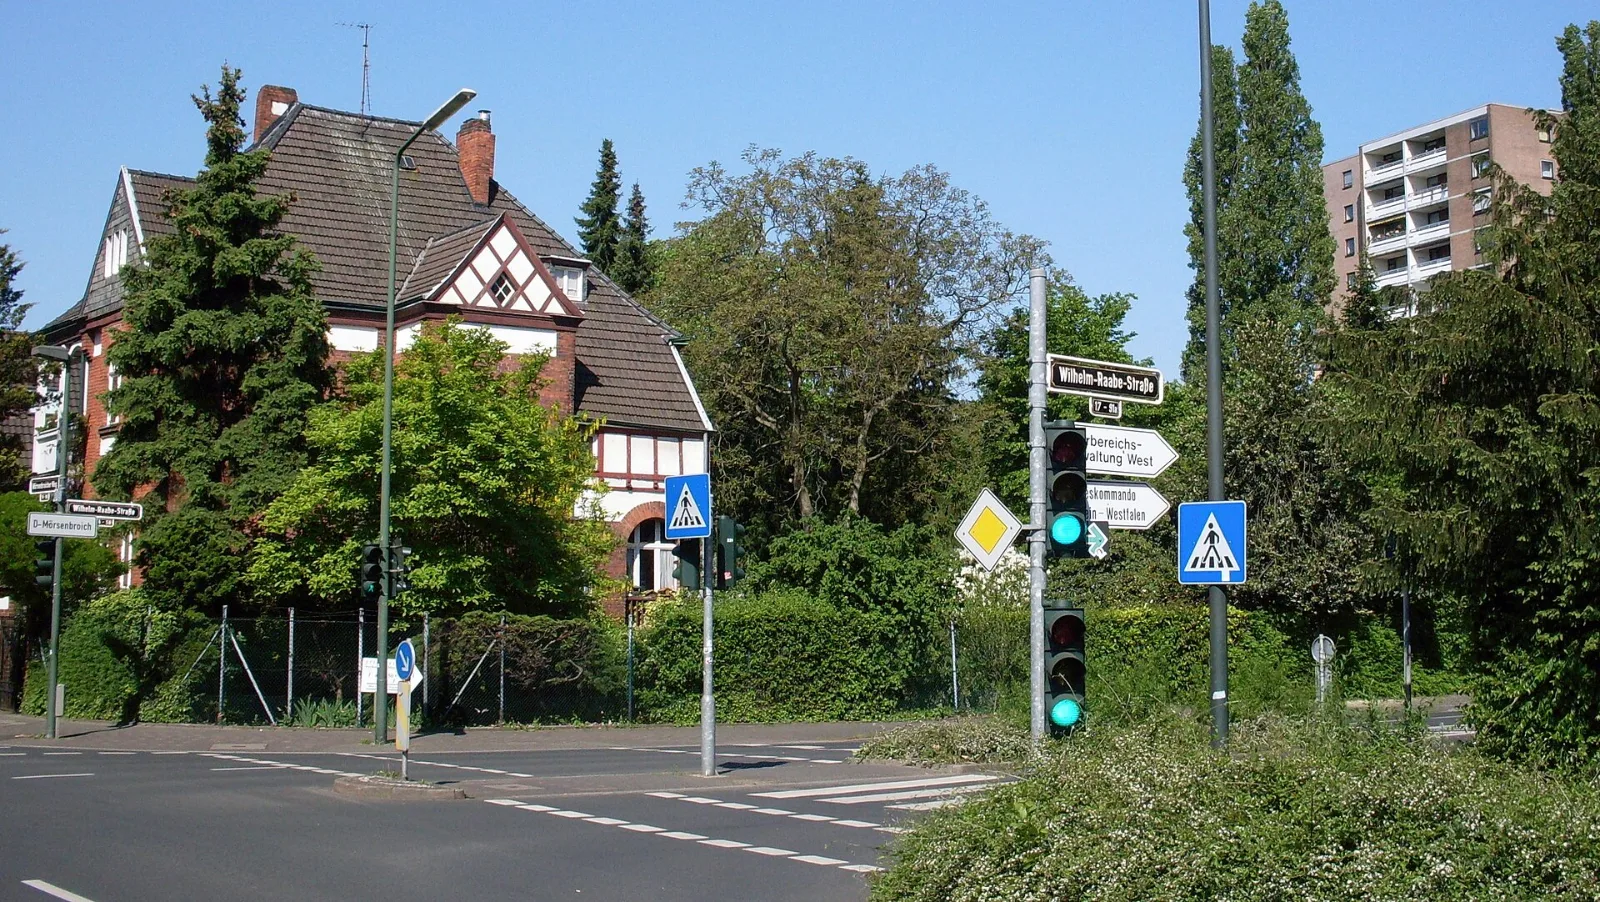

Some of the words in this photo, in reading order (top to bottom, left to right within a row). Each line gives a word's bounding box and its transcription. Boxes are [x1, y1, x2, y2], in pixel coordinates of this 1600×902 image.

[1058, 366, 1154, 394] Wilhelm-Raabe-Straße
[1094, 401, 1102, 412] 17
[1127, 453, 1154, 467] West
[72, 504, 136, 516] Wilhelm-Raabe-Straße
[1106, 507, 1146, 522] Westfalen
[33, 519, 92, 531] D-Mörsenbroich
